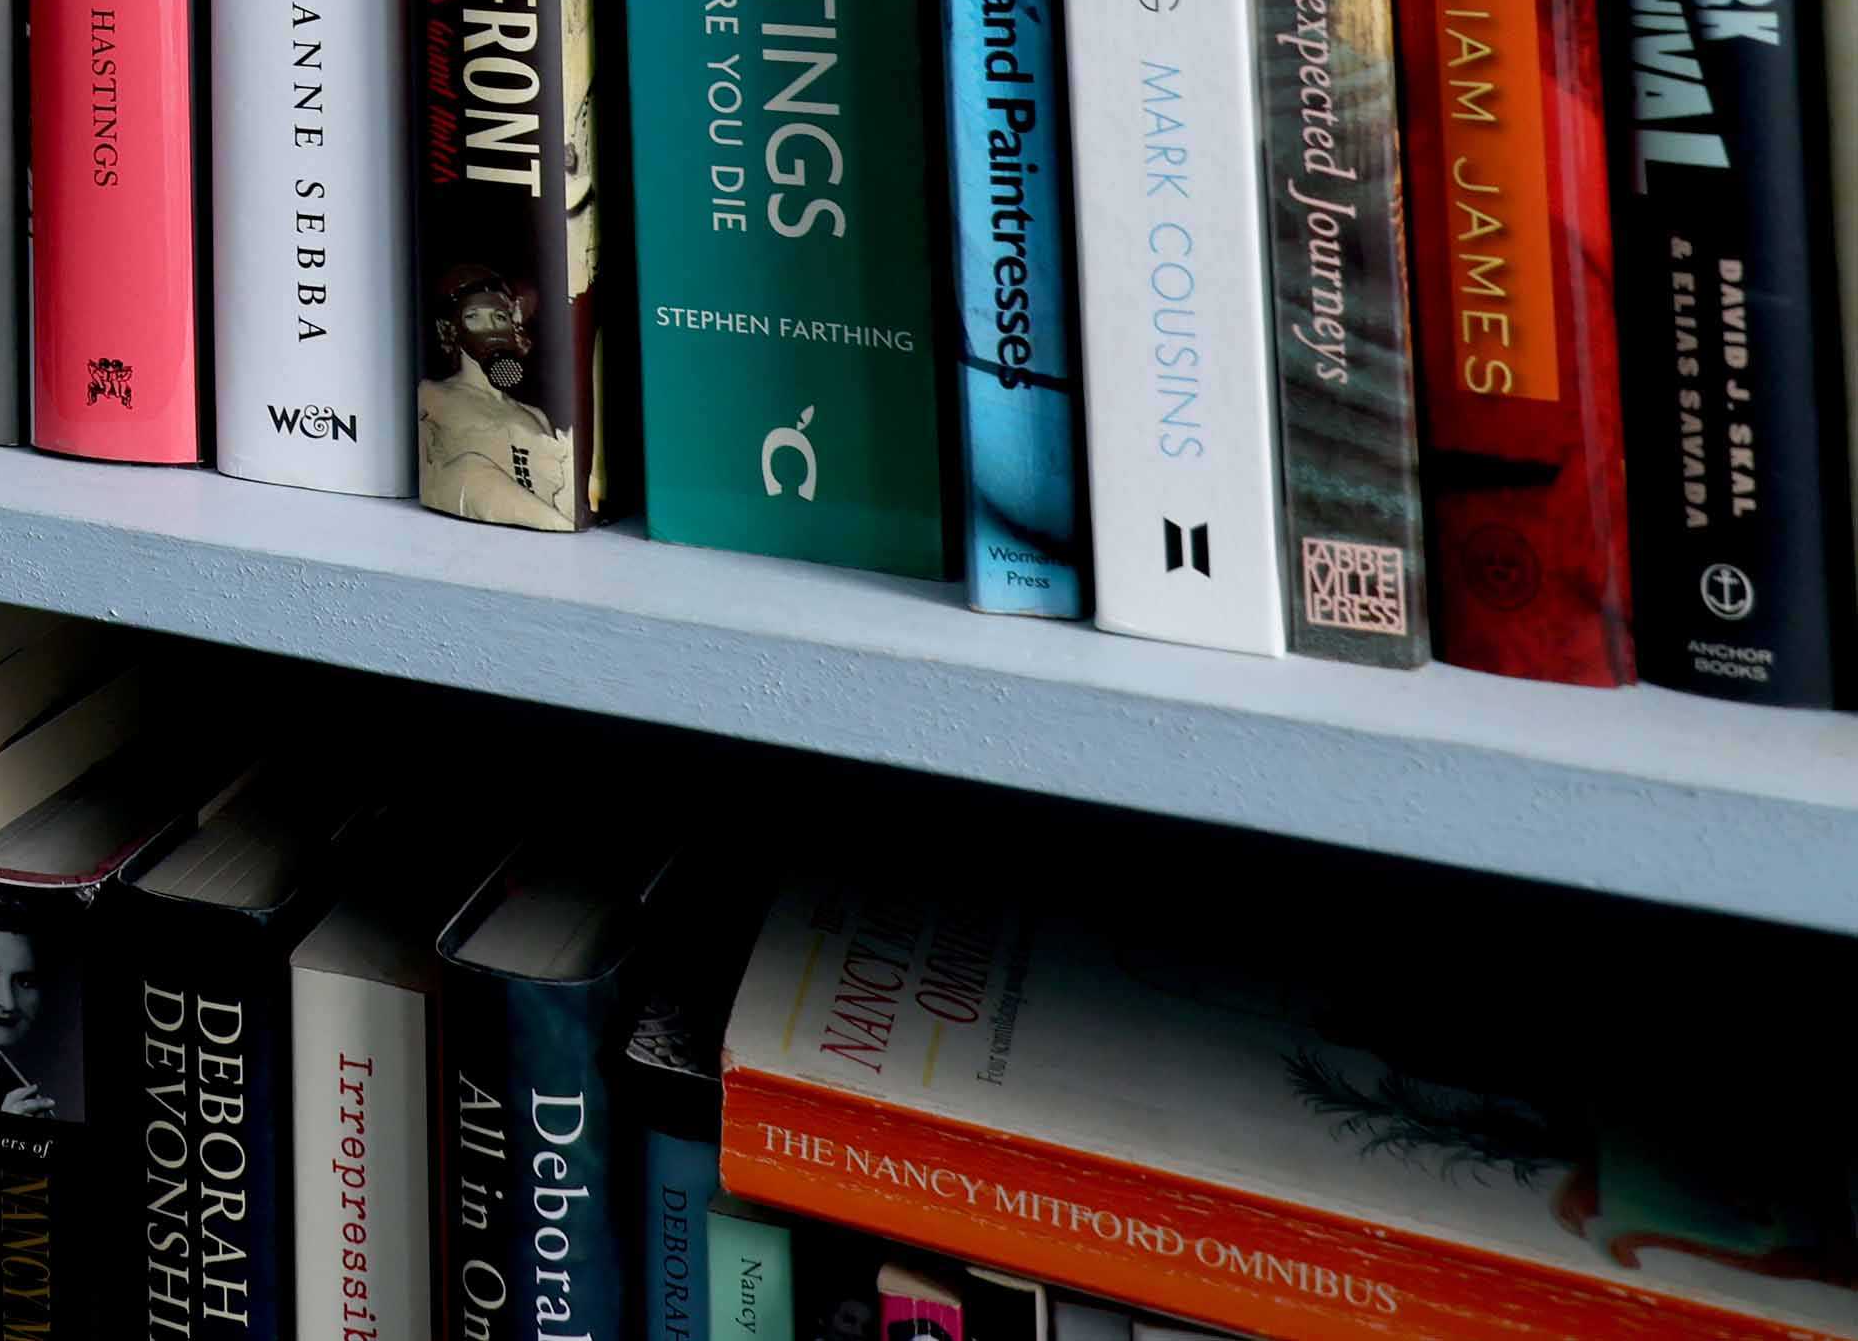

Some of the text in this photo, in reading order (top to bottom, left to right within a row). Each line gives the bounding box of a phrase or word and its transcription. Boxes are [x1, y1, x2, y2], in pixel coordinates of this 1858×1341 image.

[91, 9, 118, 188] HASTINGS
[291, 1, 328, 343] ANNE SEBBA
[1139, 61, 1190, 199] MARK
[656, 306, 914, 353] STEPHEN FARTHING
[1148, 222, 1204, 459] COUSINS
